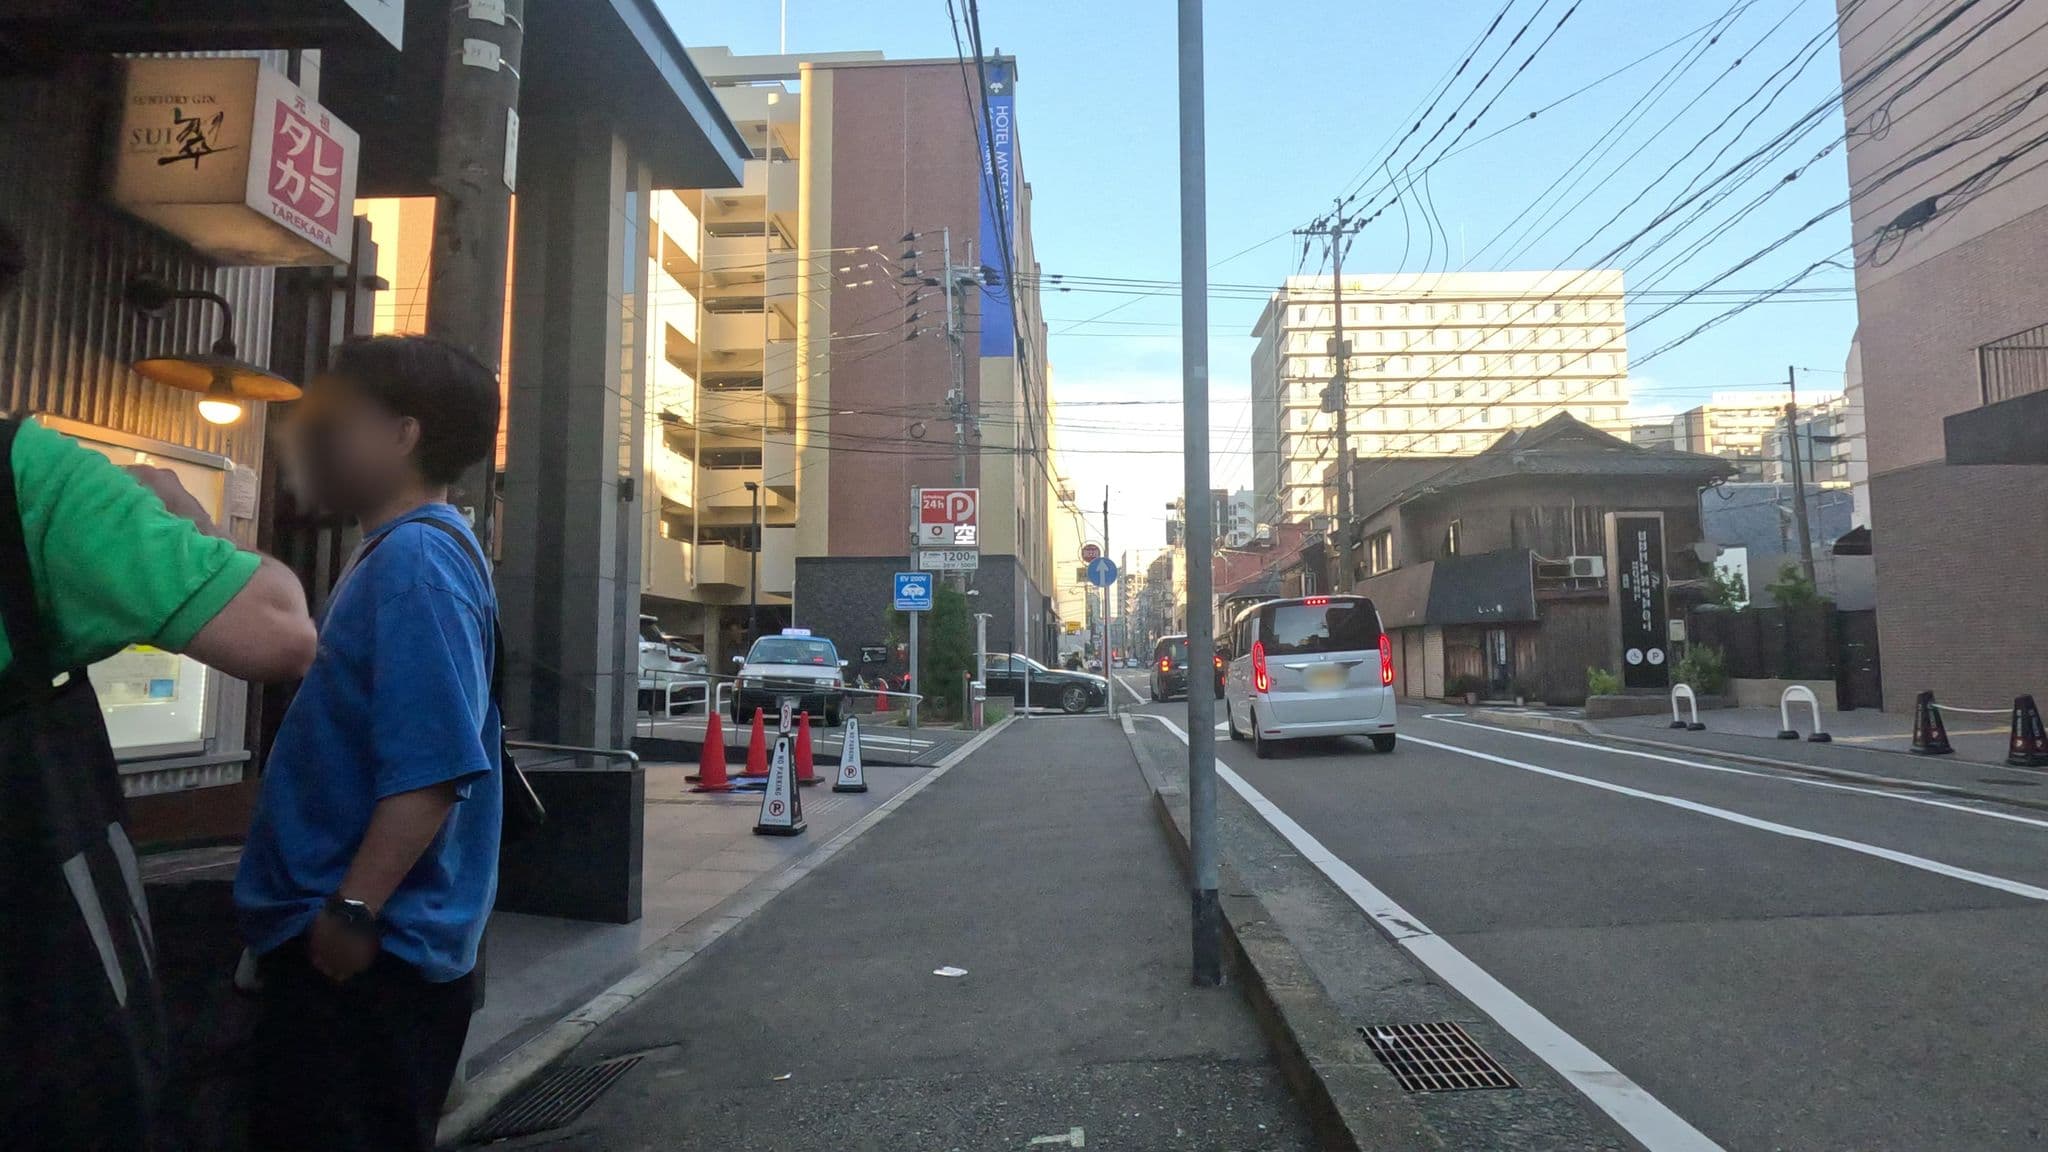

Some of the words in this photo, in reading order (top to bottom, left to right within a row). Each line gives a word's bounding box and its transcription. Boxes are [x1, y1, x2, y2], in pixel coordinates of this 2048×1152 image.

[132, 96, 187, 105] SUNTORY
[191, 95, 216, 104] GIN
[294, 96, 330, 134] 元祖
[129, 128, 171, 145] SUI
[279, 113, 337, 176] タレ
[996, 106, 1009, 147] HOTEL
[274, 158, 335, 218] カラ
[272, 202, 332, 247] TAREKARA
[923, 501, 944, 509] 24h
[946, 492, 974, 521] P
[954, 523, 976, 545] 空
[1632, 561, 1641, 601] HOTEL
[1638, 531, 1651, 632] BREAKFAST
[778, 755, 785, 764] NO
[775, 767, 784, 796] PARKING
